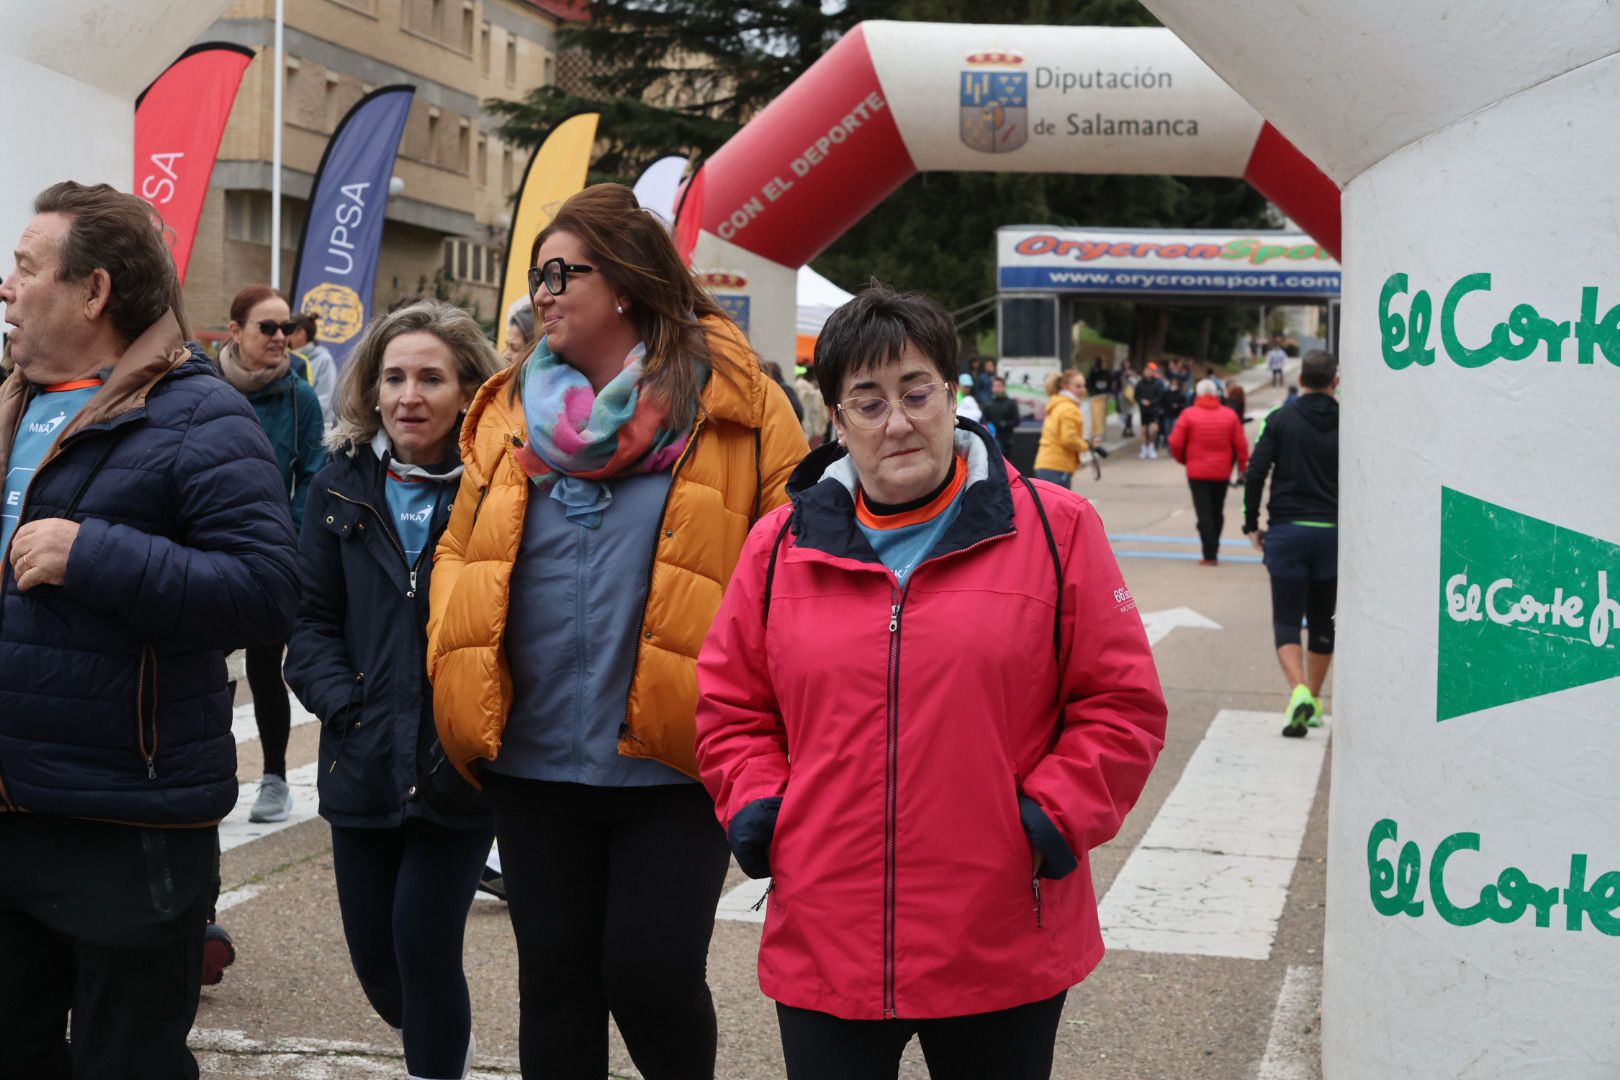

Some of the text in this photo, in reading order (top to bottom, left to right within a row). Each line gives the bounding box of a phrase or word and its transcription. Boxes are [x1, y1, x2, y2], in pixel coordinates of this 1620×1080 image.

[1035, 66, 1173, 95] Diputación
[1033, 112, 1199, 136] de Salamanca
[717, 91, 886, 240] CON EL DEPORTE
[324, 181, 371, 275] UPSA
[1049, 270, 1340, 289] www.orycronsport.com
[1379, 272, 1436, 371] El
[400, 512, 422, 521] MKA
[1445, 573, 1483, 622] El
[1485, 578, 1585, 628] Corte
[1367, 818, 1424, 918] El
